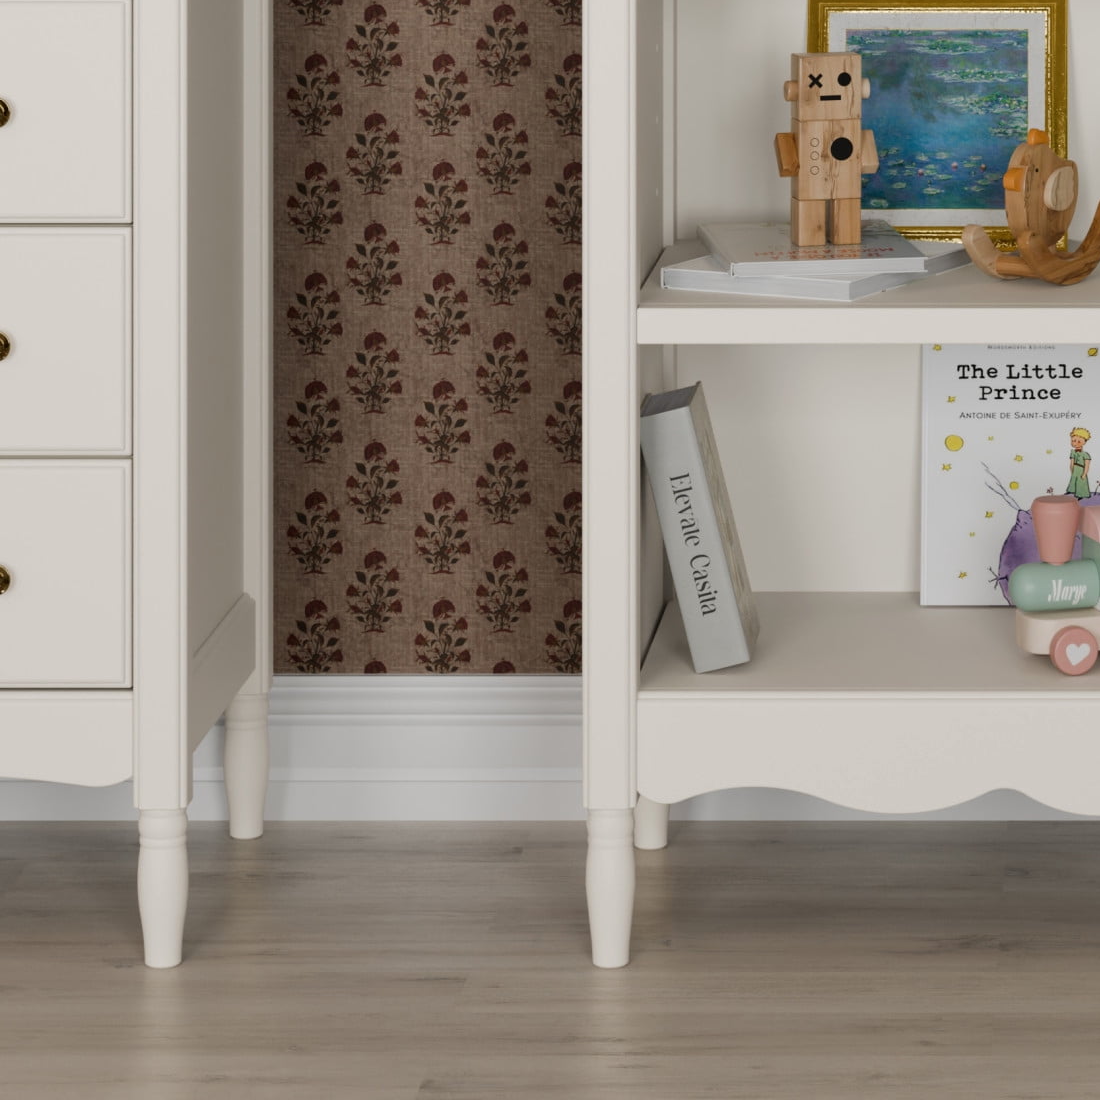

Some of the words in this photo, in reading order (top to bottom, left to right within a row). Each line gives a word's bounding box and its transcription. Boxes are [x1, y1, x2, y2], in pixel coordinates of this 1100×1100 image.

[957, 364, 998, 380] The
[1006, 364, 1083, 380] Little
[979, 385, 1061, 400] Prince
